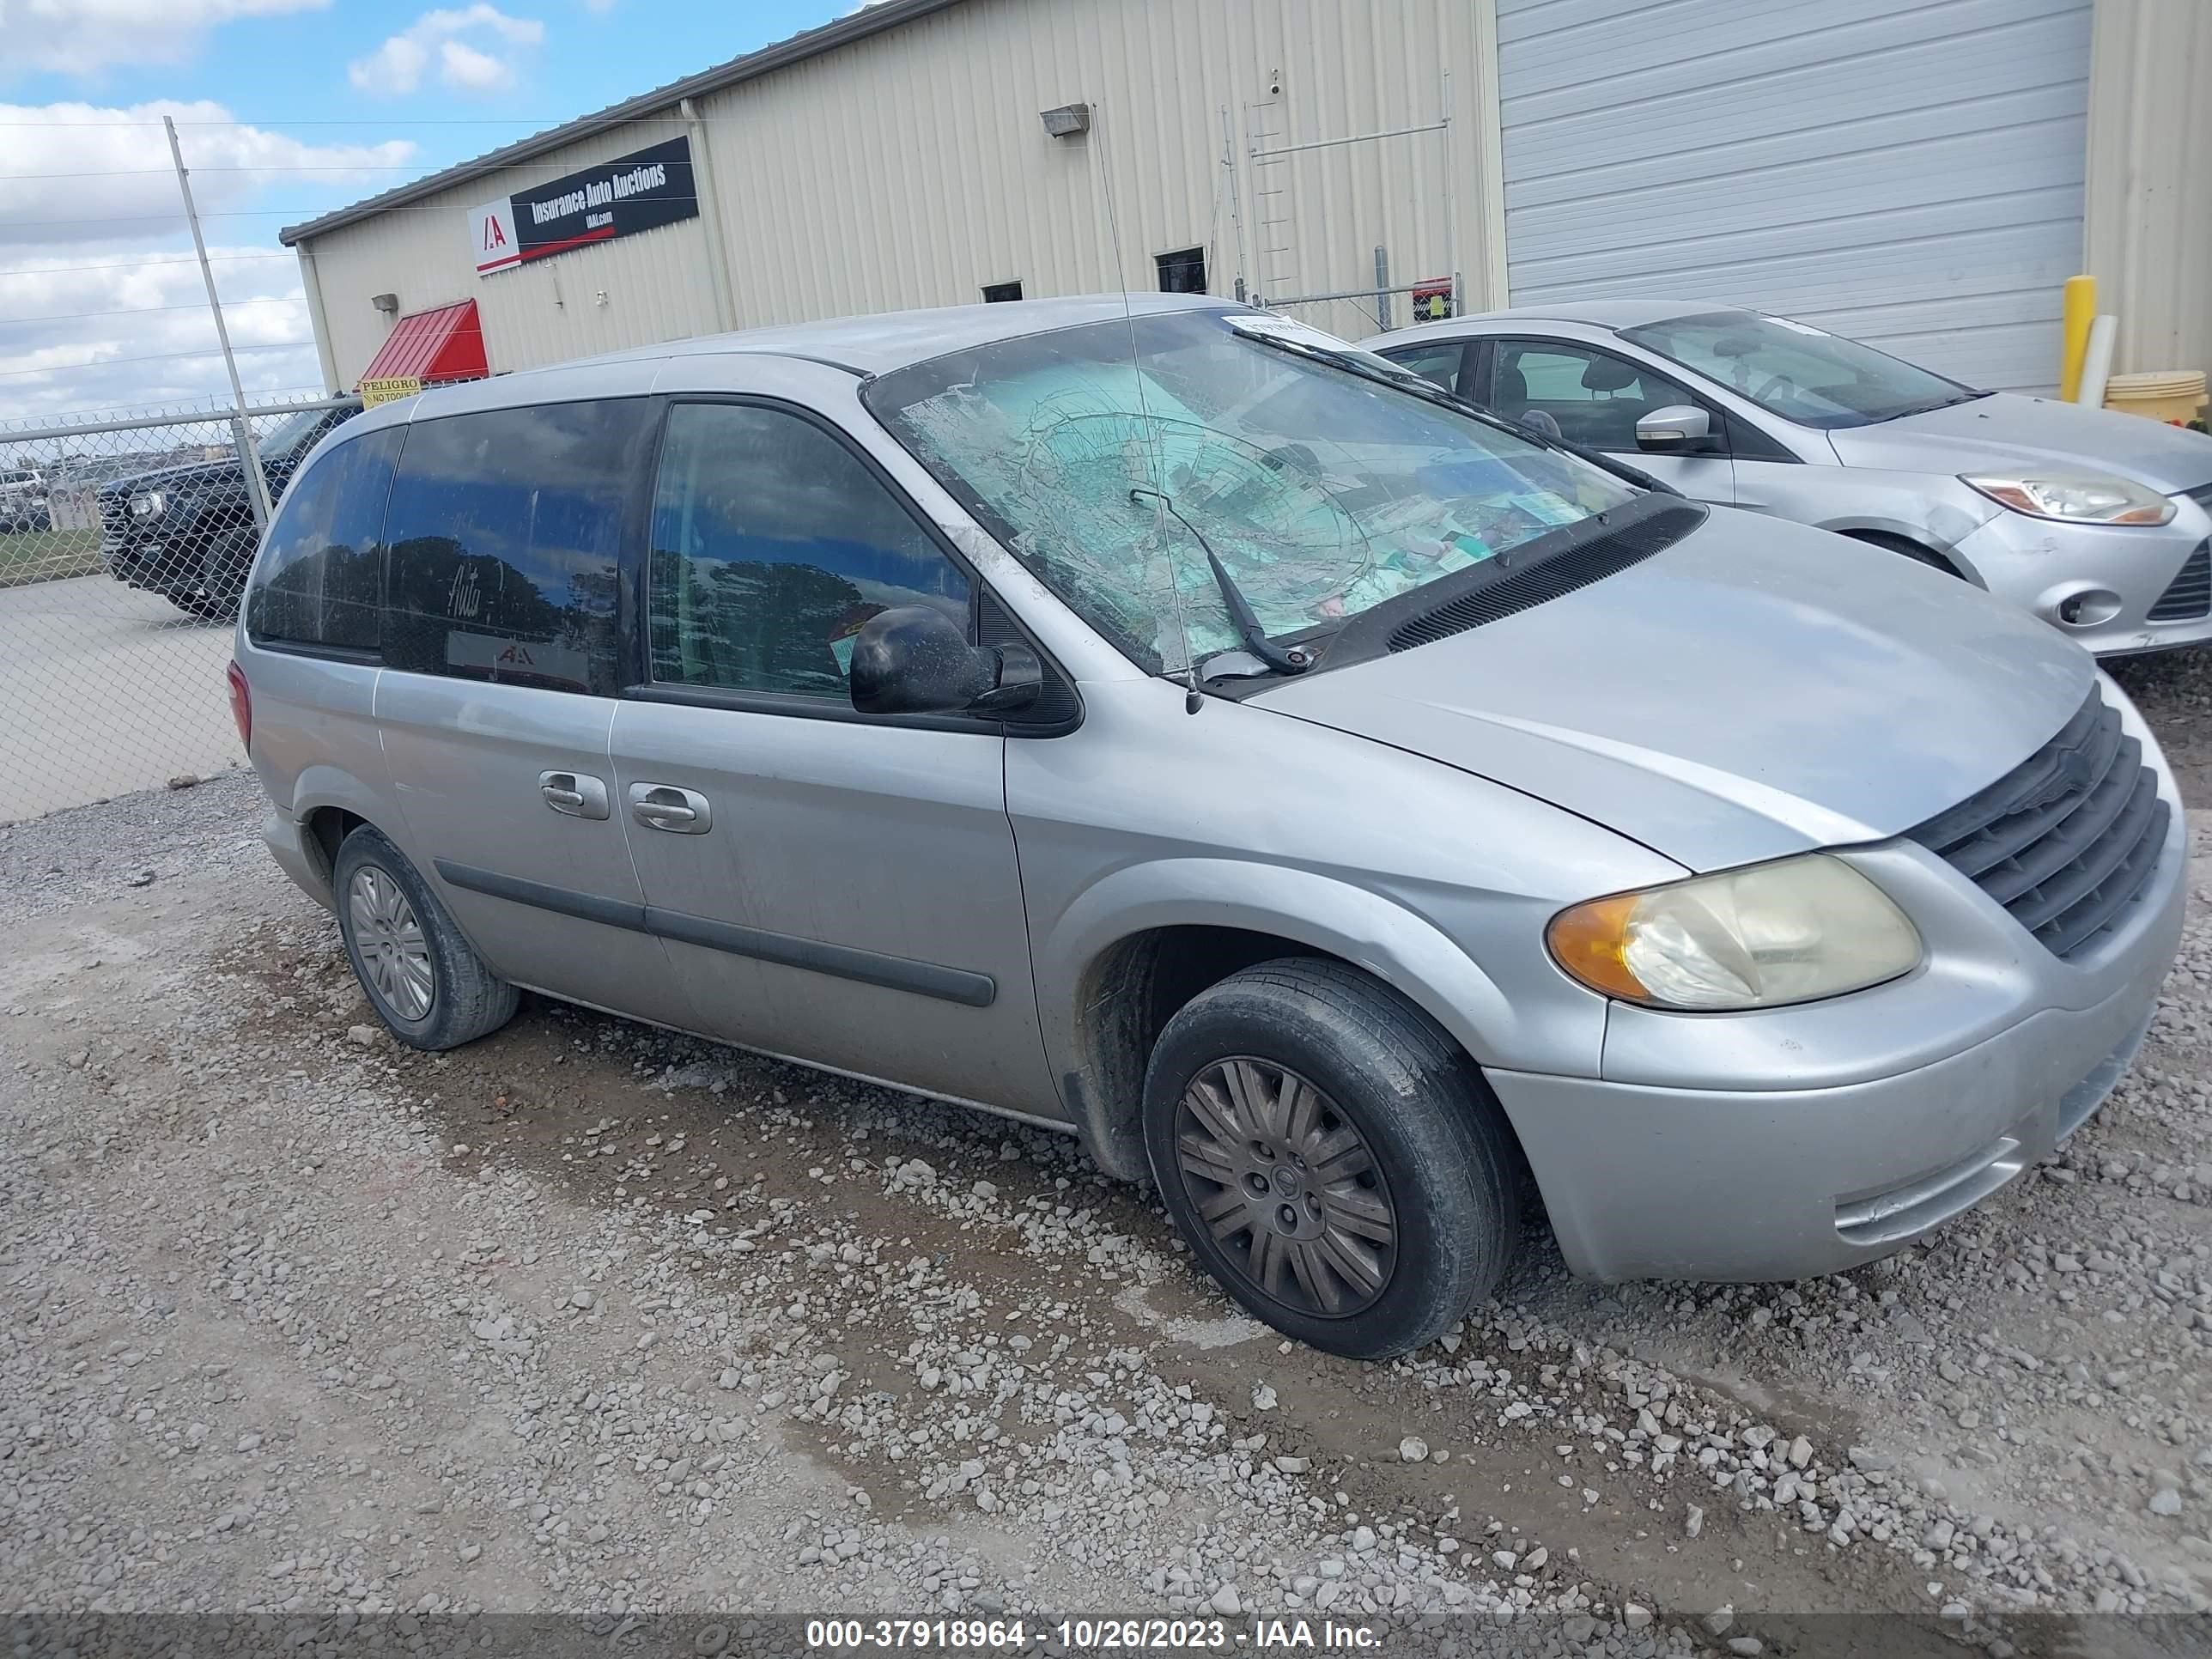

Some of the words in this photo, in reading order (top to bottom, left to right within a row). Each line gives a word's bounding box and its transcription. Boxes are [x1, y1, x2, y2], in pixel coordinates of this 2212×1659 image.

[532, 190, 586, 225] Insurance
[586, 181, 612, 208] Auto
[612, 164, 666, 199] Auctions
[586, 211, 613, 229] IAAI.com
[362, 379, 417, 392] PELIGRO
[373, 393, 385, 402] NO
